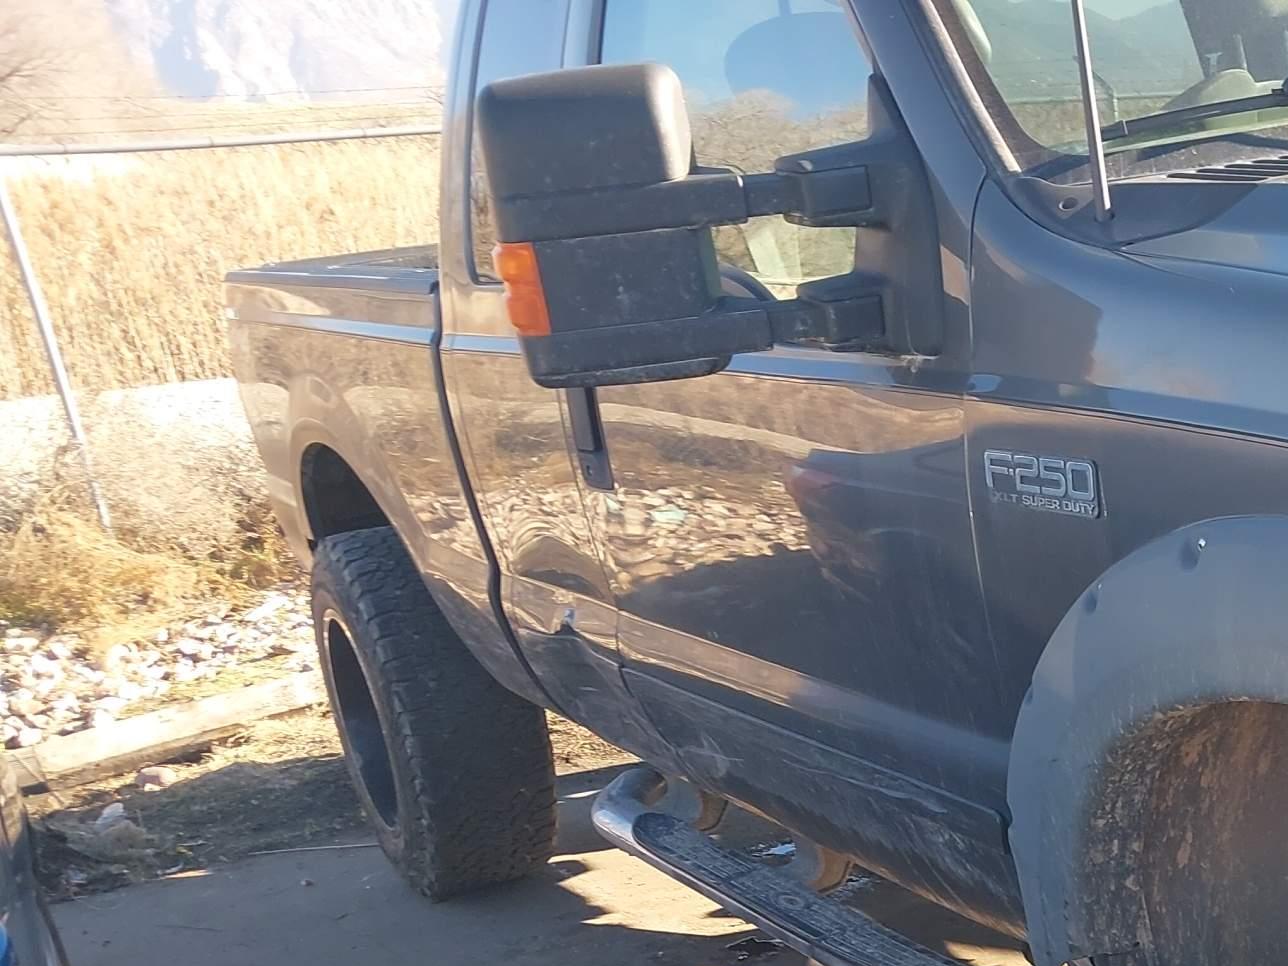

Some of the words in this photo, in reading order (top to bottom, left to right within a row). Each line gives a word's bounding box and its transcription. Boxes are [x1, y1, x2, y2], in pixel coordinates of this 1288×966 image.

[984, 451, 1095, 501] F-250
[1022, 495, 1060, 510] SUPER
[1063, 500, 1096, 516] DUTY
